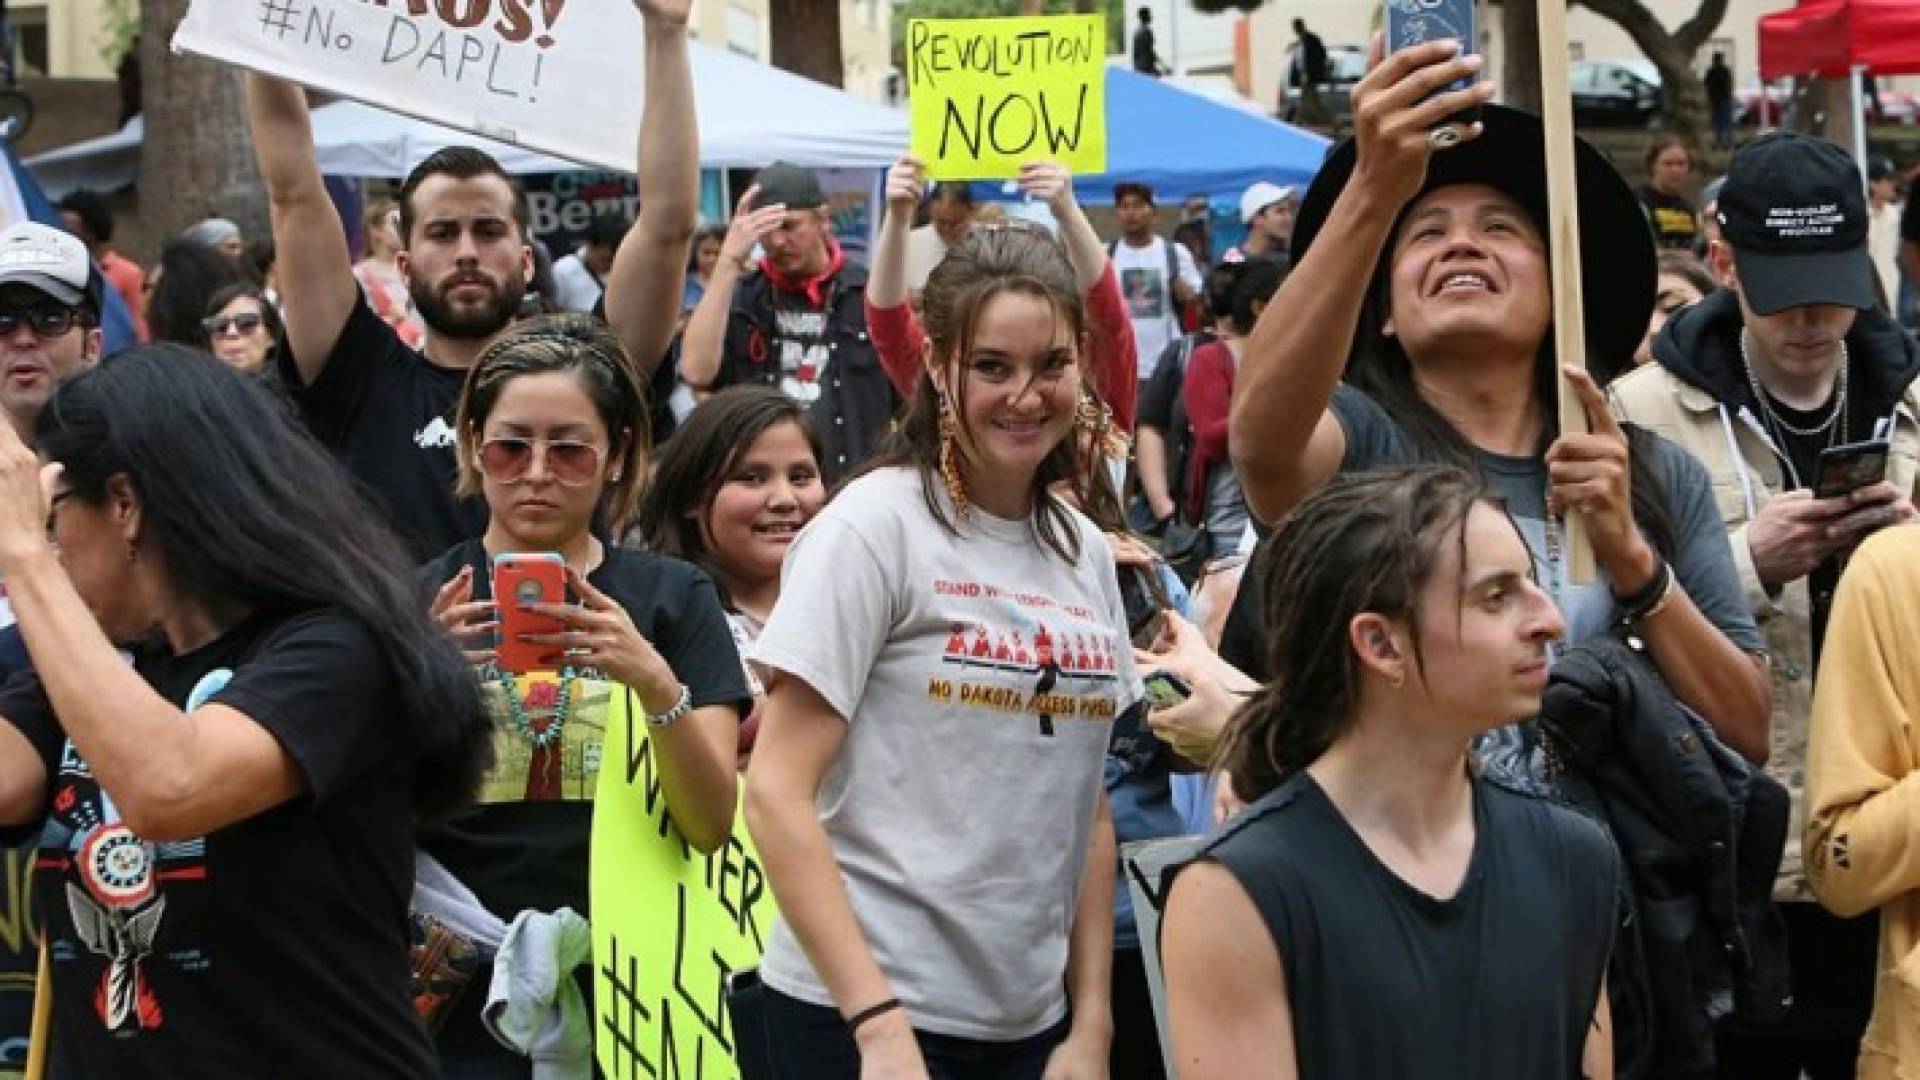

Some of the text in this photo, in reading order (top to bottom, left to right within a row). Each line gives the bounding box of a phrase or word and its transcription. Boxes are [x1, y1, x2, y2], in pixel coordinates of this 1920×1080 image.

[381, 14, 544, 103] DAPL!
[912, 21, 1095, 88] REVOLUTION
[938, 83, 1088, 160] NOW
[928, 678, 952, 699] NO
[960, 681, 1022, 711] DAKOTA
